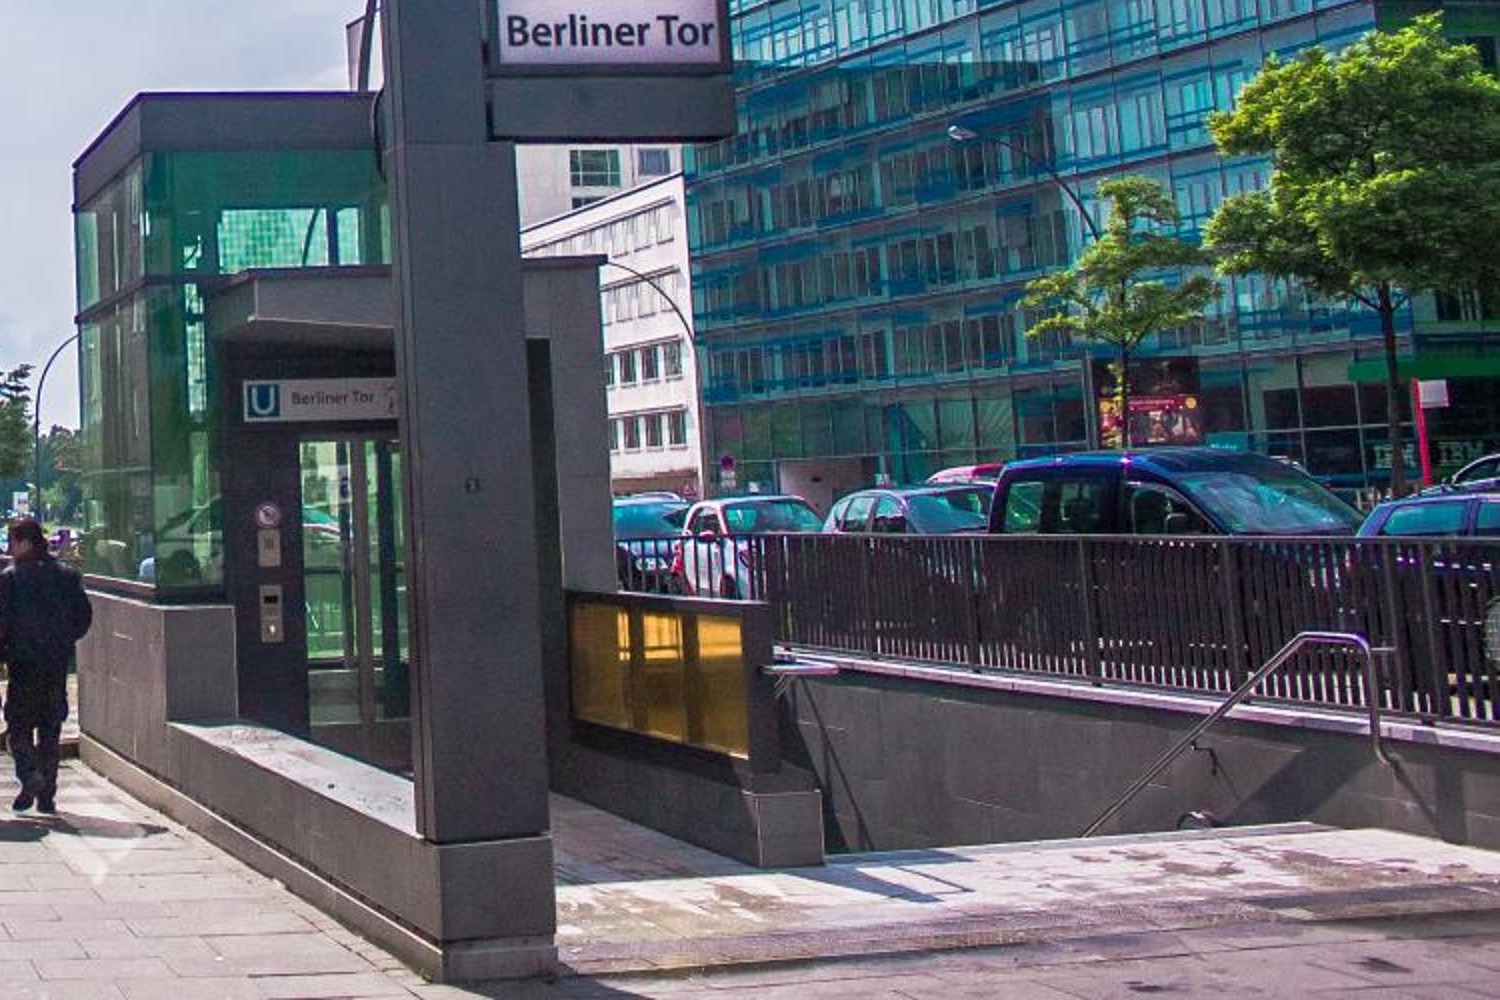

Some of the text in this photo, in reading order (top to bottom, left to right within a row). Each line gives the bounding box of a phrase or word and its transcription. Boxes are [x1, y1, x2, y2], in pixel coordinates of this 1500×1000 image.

[507, 13, 714, 47] Berliner Tor
[251, 386, 277, 415] U
